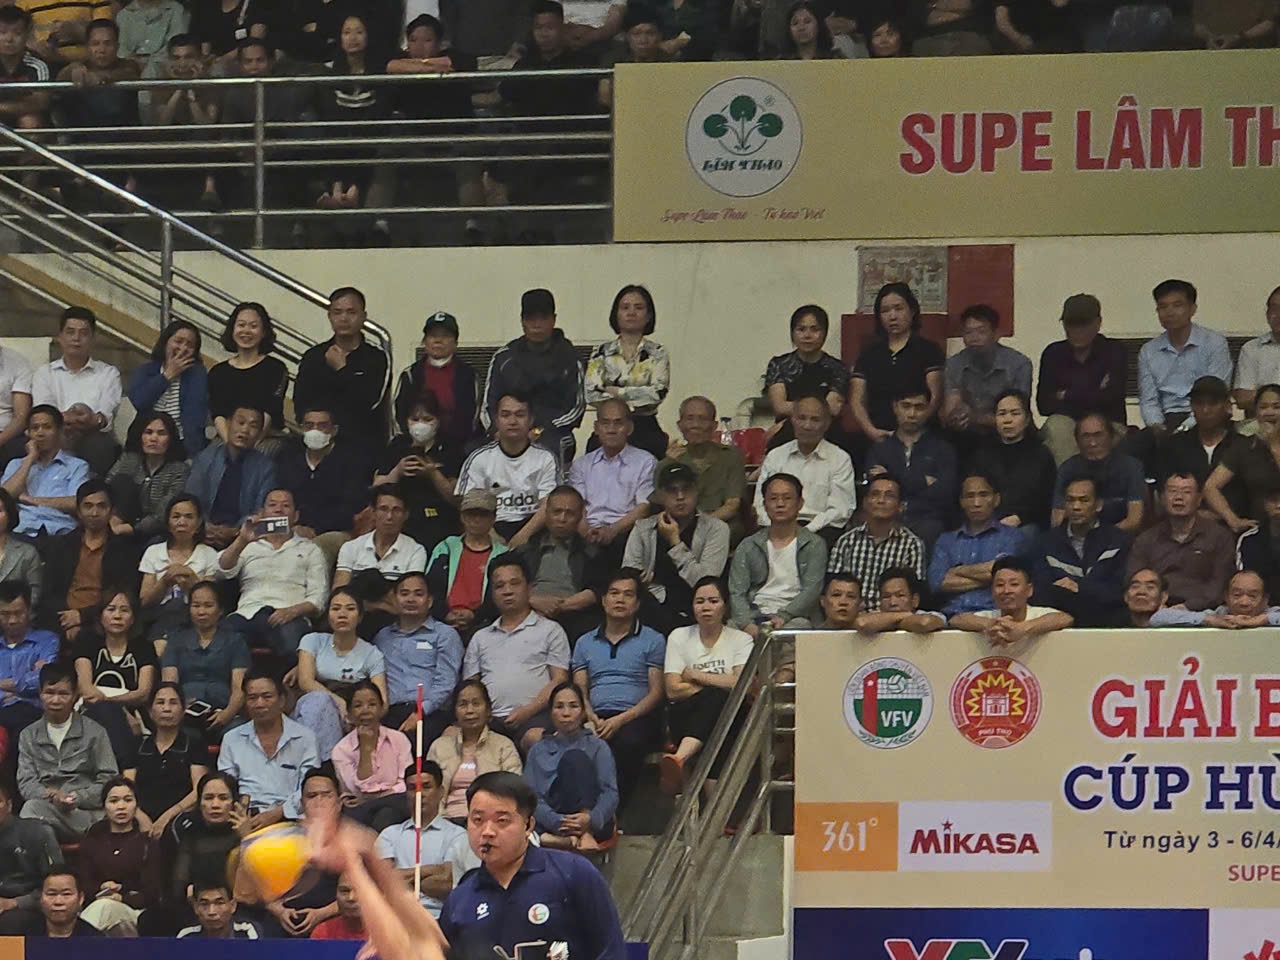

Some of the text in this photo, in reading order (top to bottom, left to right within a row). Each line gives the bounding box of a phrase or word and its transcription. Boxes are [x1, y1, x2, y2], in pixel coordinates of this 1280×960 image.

[899, 110, 1054, 175] SUPE
[1074, 95, 1204, 171] LÂM
[1091, 656, 1238, 739] GIẢI
[880, 710, 914, 727] VFV
[1064, 753, 1190, 811] CÚP
[1104, 830, 1136, 849] Từ
[1142, 831, 1200, 853] ngày
[1207, 830, 1219, 849] 3
[1228, 864, 1280, 882] SUPE
